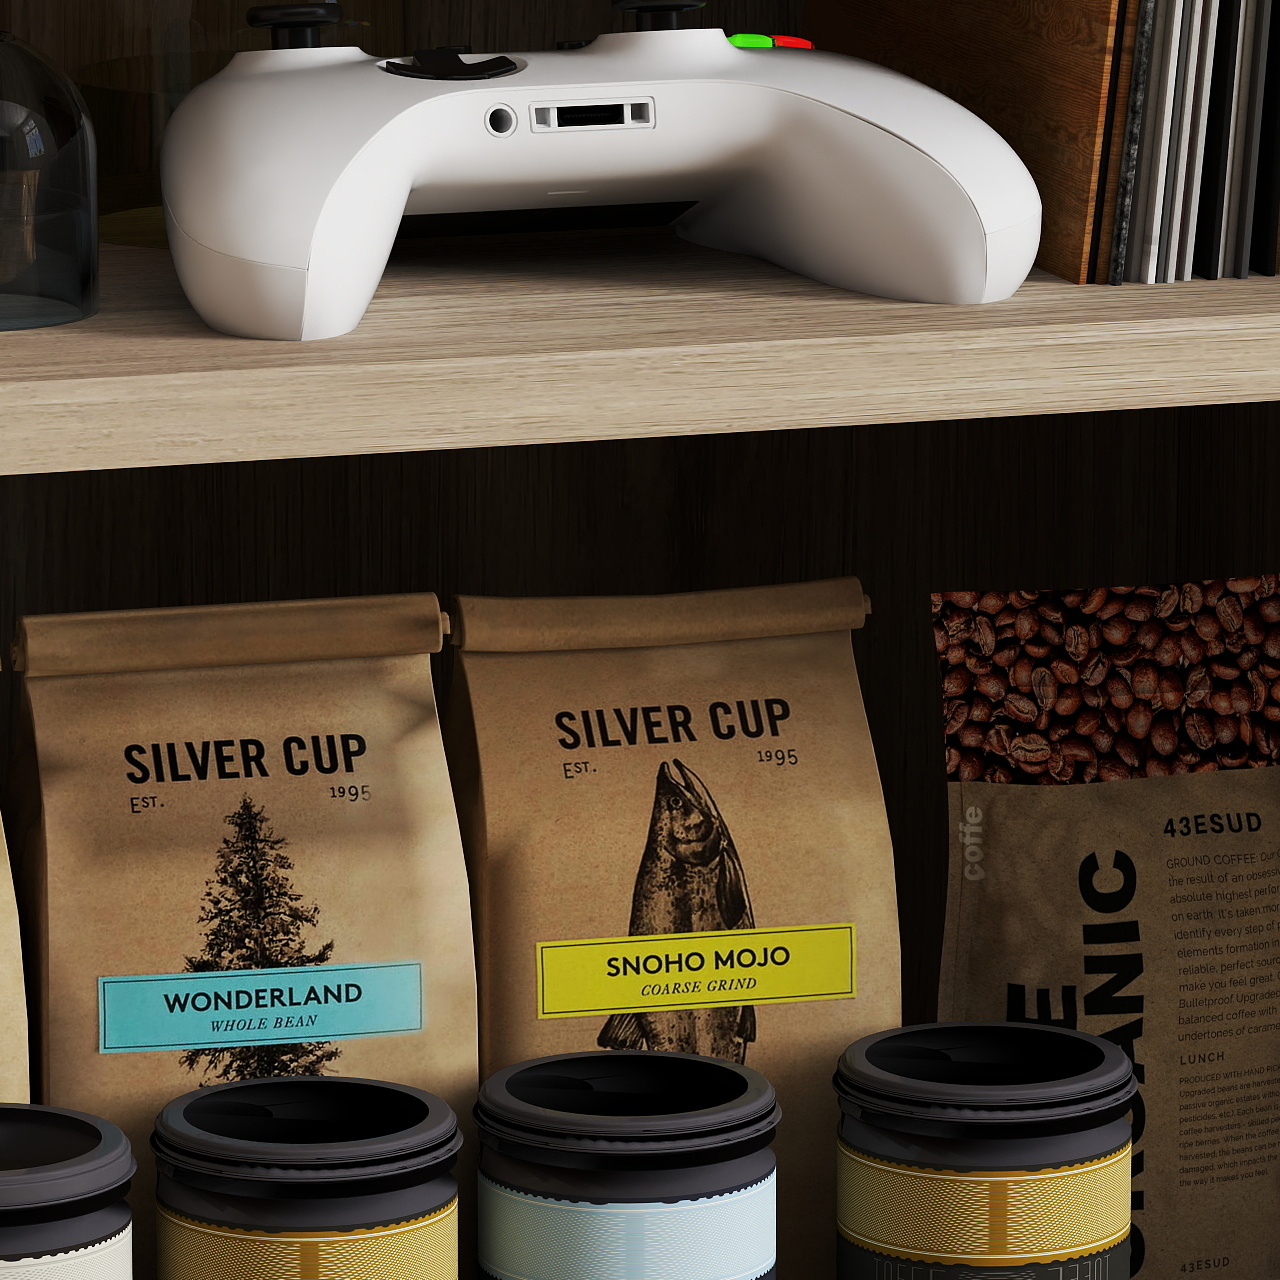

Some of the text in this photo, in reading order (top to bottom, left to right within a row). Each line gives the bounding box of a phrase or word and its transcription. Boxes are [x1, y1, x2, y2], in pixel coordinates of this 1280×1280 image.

[555, 698, 790, 750] SILVER CUP
[124, 734, 367, 784] SILVER CUP
[563, 749, 798, 778] EST. 1995
[130, 785, 372, 813] EST. 1995
[1164, 812, 1262, 837] 43ESUD
[959, 806, 985, 881] coffe
[1167, 855, 1210, 869] GROUND
[1214, 853, 1259, 865] COFFEE:
[1260, 851, 1275, 862] Our
[1168, 878, 1183, 887] the
[1186, 871, 1214, 884] result
[1218, 873, 1229, 882] of
[1232, 874, 1243, 882] an
[1170, 892, 1212, 904] absolute
[1216, 890, 1252, 902] highest
[1172, 913, 1183, 922] on
[1187, 910, 1216, 920] earth.
[1218, 909, 1233, 919] It's
[1236, 905, 1260, 917] taken
[1174, 920, 1275, 940] identify every step of
[1177, 946, 1223, 958] elements
[1226, 942, 1269, 954] formation
[607, 946, 790, 977] SNOHO MOJO
[1220, 960, 1254, 974] perfect
[641, 978, 757, 997] COARSE GRIND
[1180, 982, 1206, 992] make
[1209, 982, 1226, 992] you
[1229, 977, 1247, 987] feel
[163, 983, 362, 1014] WONDERLAND
[1236, 990, 1280, 1004] Upgraded
[211, 1015, 318, 1032] WHOLE BEAN
[1179, 1013, 1223, 1025] balanced
[1226, 1009, 1256, 1021] coffee
[1259, 1005, 1277, 1016] with
[1178, 1029, 1233, 1041] undertones
[1236, 1026, 1245, 1036] of
[1078, 849, 1145, 1278] ANIC
[1181, 1052, 1224, 1065] LUNCH
[1180, 1257, 1230, 1273] 43ESUD
